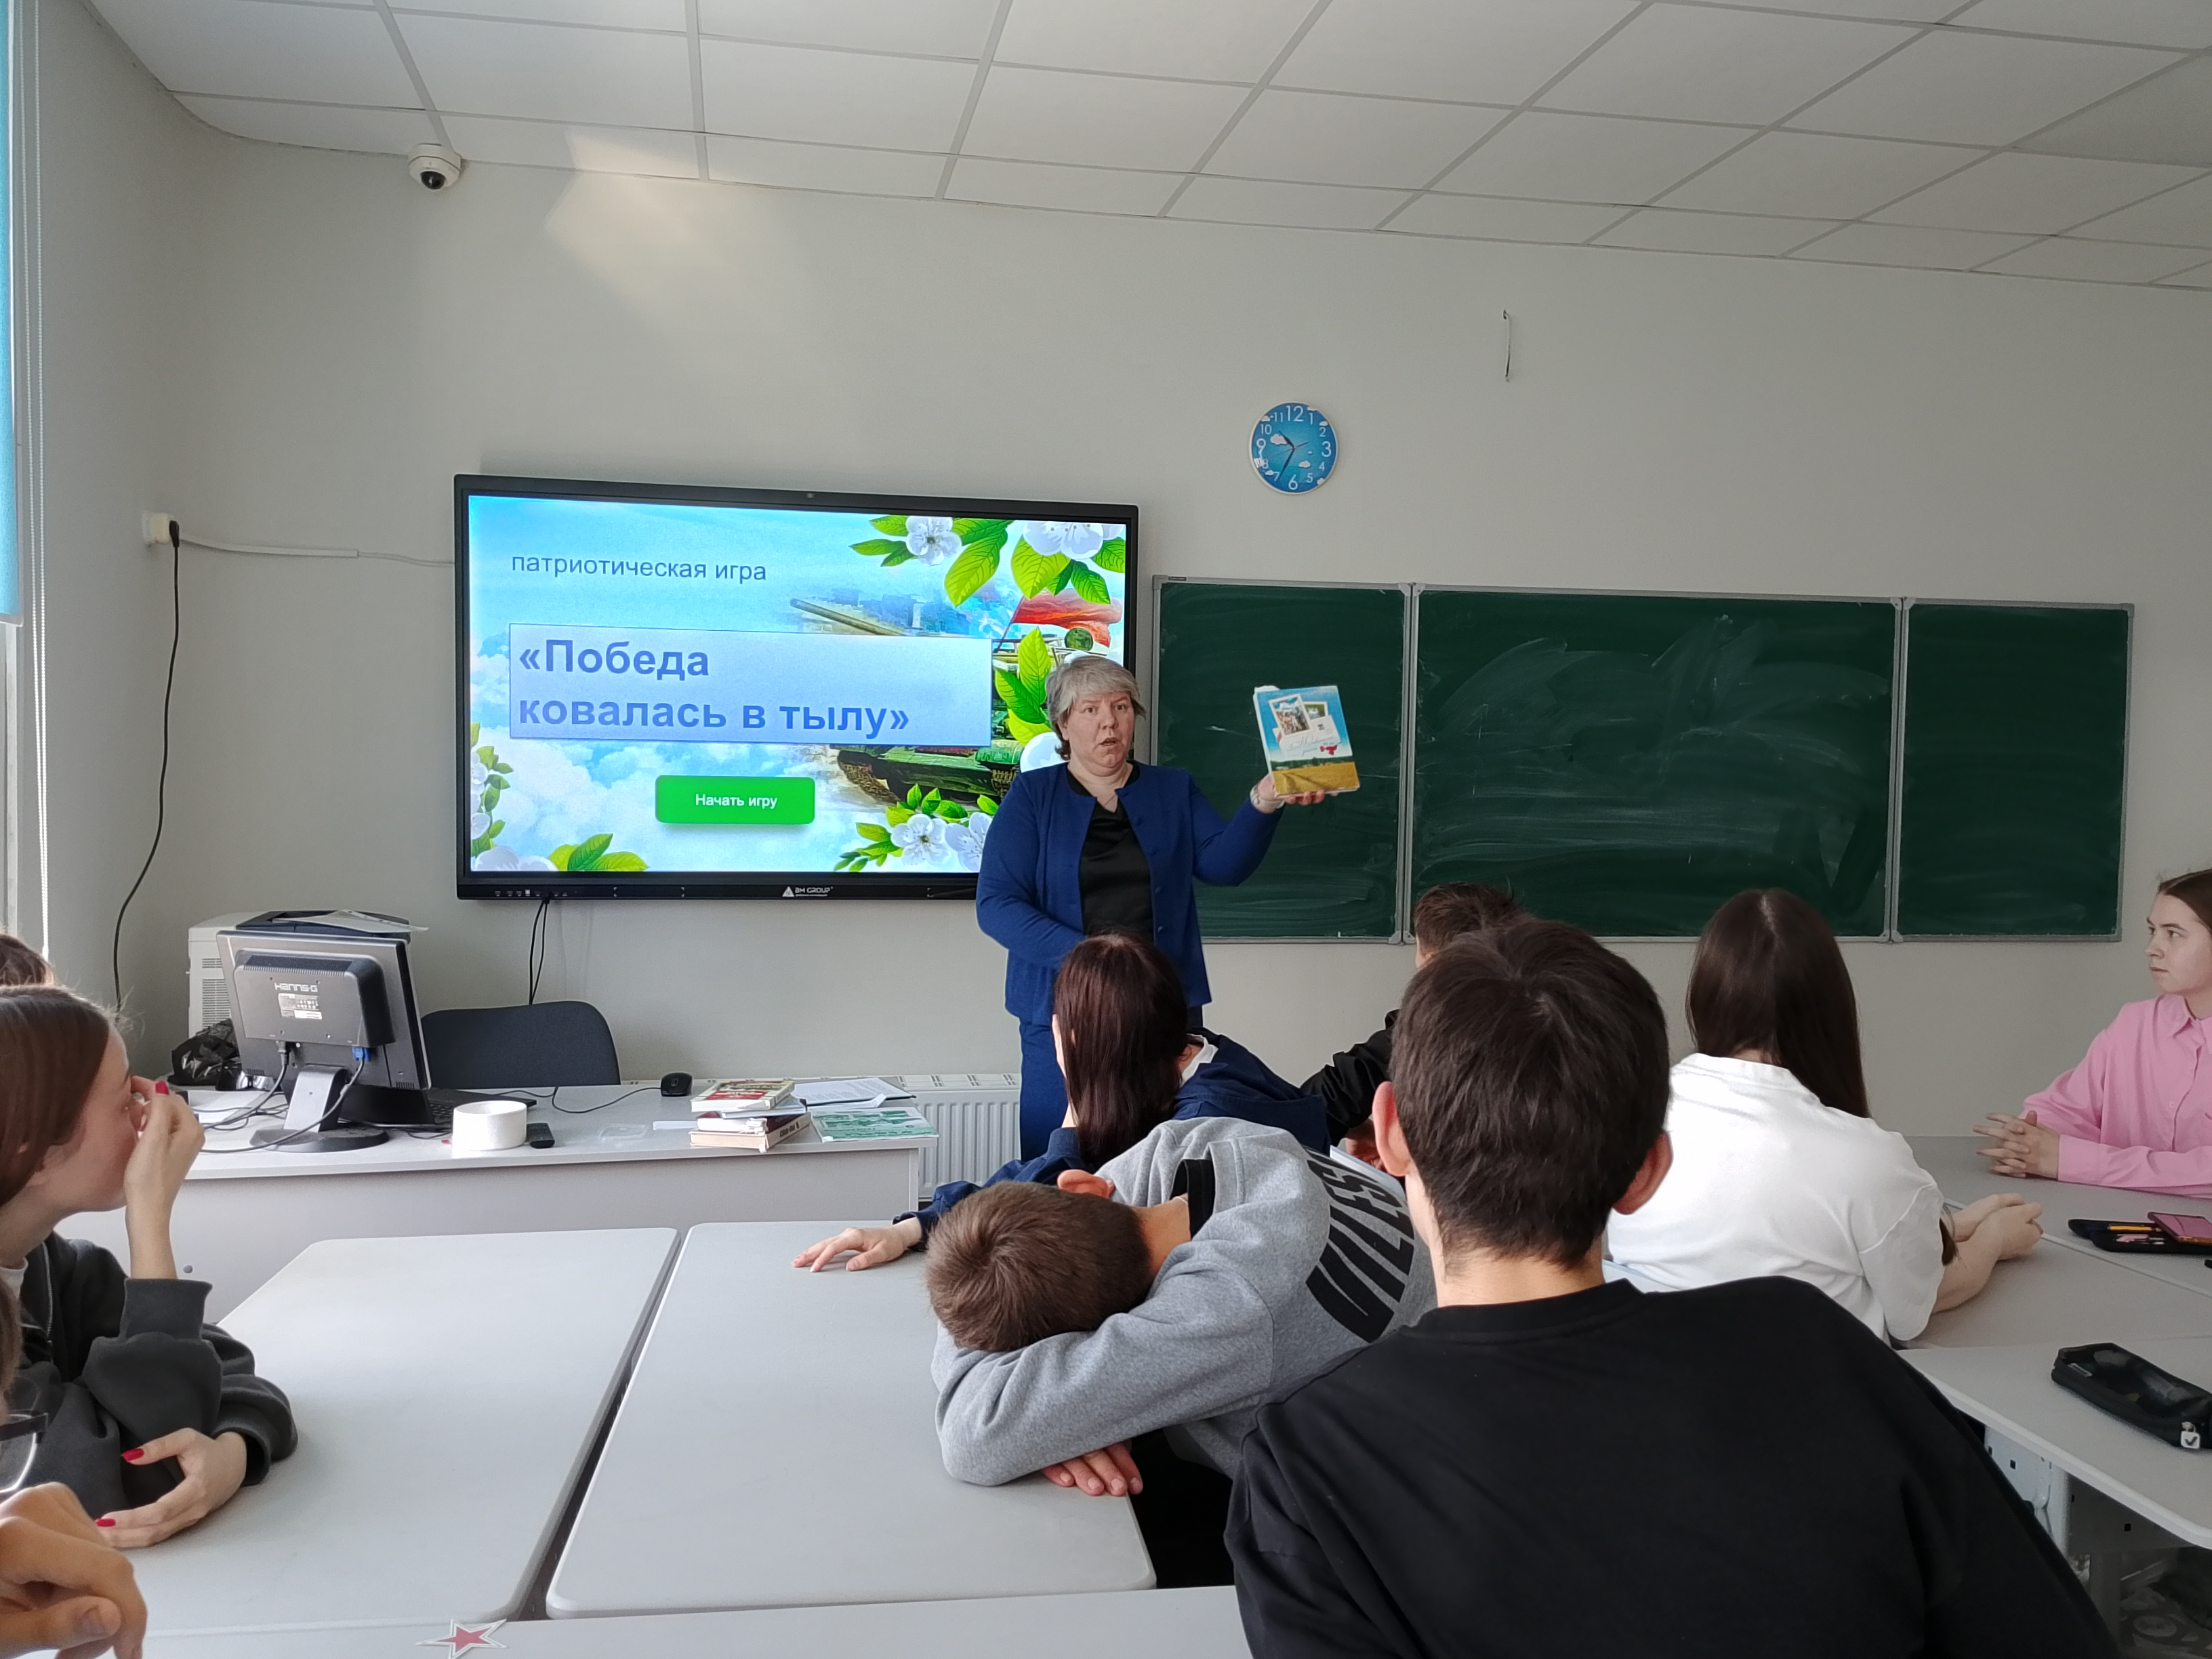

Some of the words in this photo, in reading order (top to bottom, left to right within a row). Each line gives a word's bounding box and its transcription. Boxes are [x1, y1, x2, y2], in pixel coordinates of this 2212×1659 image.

[1274, 411, 1284, 422] 11
[1286, 405, 1303, 422] 12
[1309, 412, 1313, 425] 1
[1261, 424, 1272, 434] 10
[1319, 427, 1326, 437] 2
[1256, 438, 1266, 459] 9
[1322, 441, 1332, 457] 3
[1262, 458, 1269, 469] 8
[1318, 462, 1325, 471] 4
[1273, 472, 1280, 482] 7
[1288, 474, 1298, 490] 6
[1306, 473, 1313, 483] 5
[512, 556, 706, 577] патриотическая
[716, 564, 766, 584] игра
[519, 639, 709, 680] «Победа
[519, 699, 726, 728] ковалась
[743, 705, 766, 729] в
[779, 706, 909, 739] тылу»
[695, 794, 744, 806] Начать
[748, 797, 777, 809] игру
